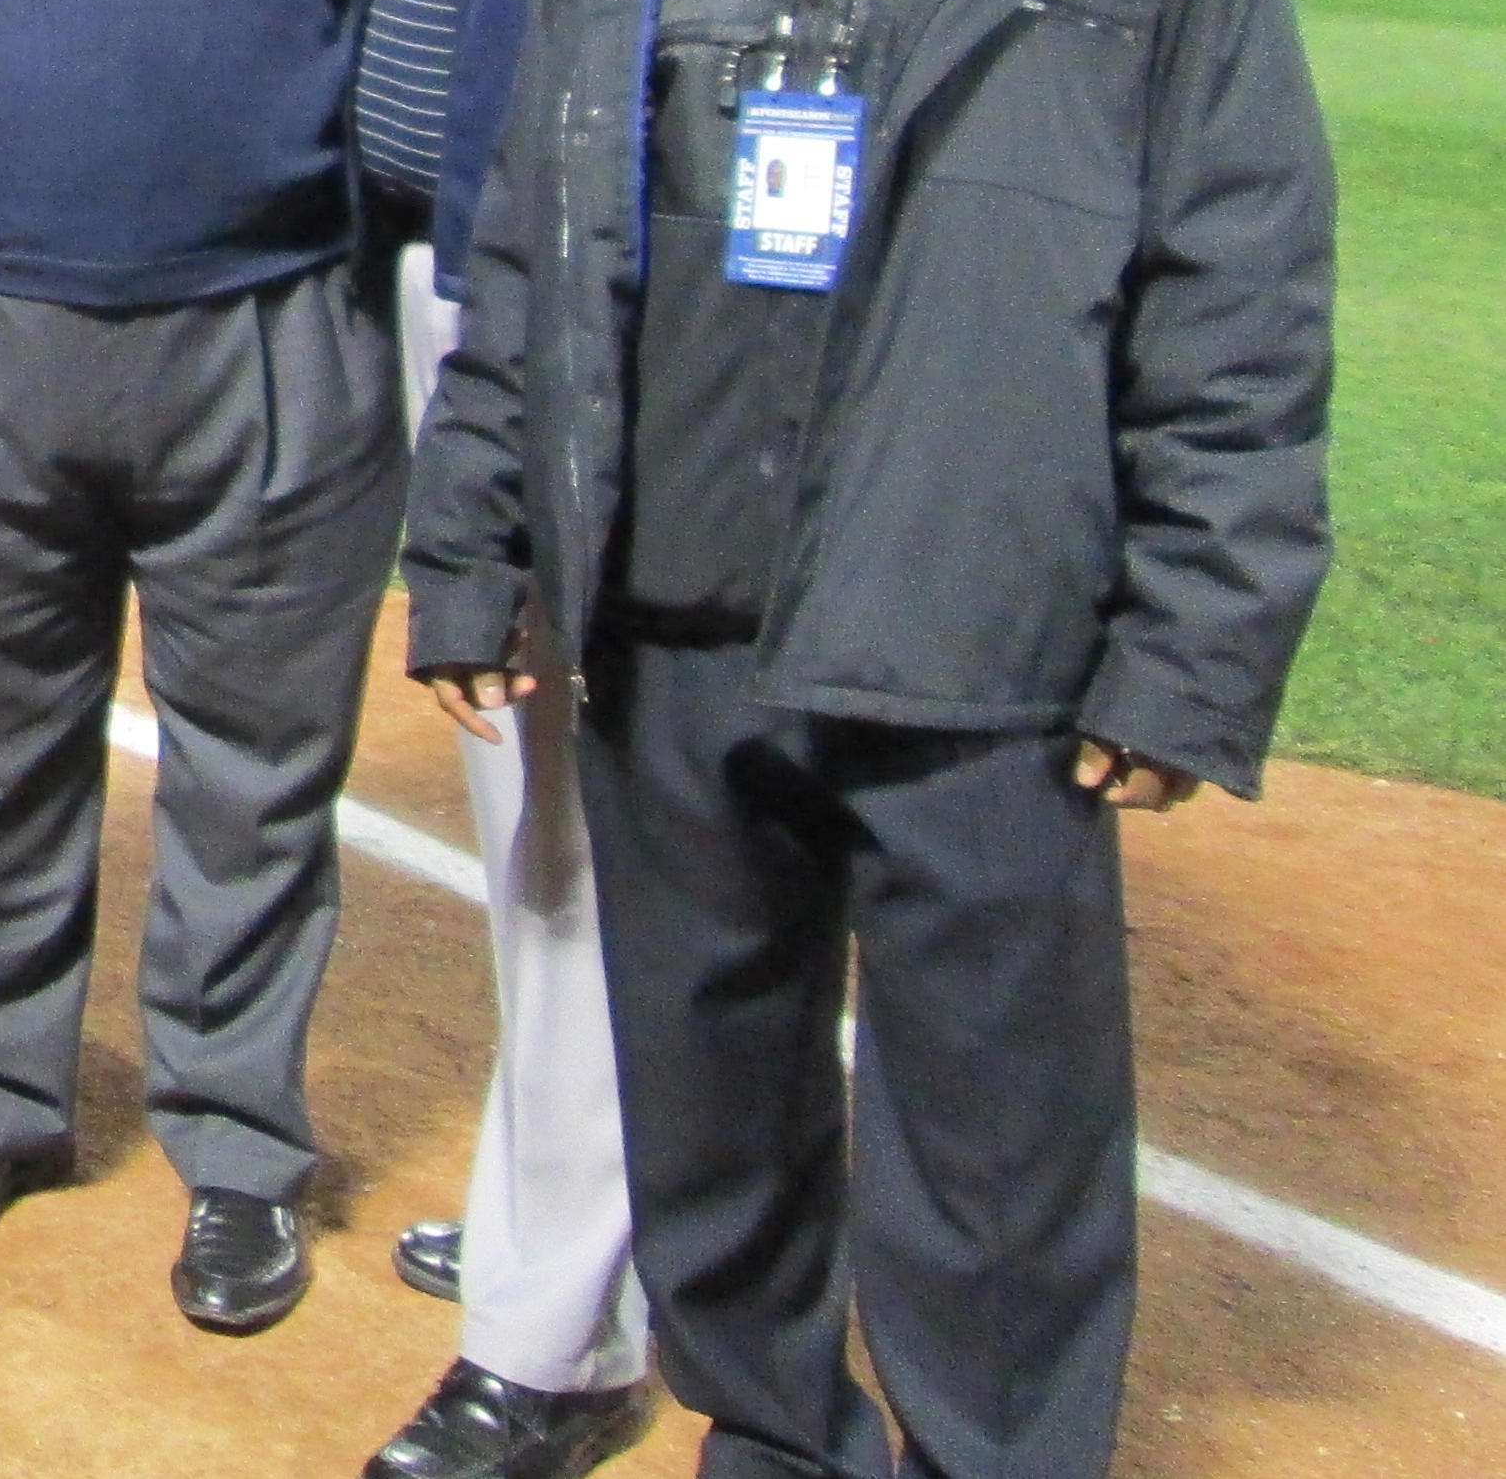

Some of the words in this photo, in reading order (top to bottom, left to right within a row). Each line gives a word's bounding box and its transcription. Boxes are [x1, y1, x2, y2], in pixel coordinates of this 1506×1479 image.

[733, 159, 755, 229] STAFF
[832, 166, 853, 238] STAFF
[760, 232, 818, 254] STAFF
